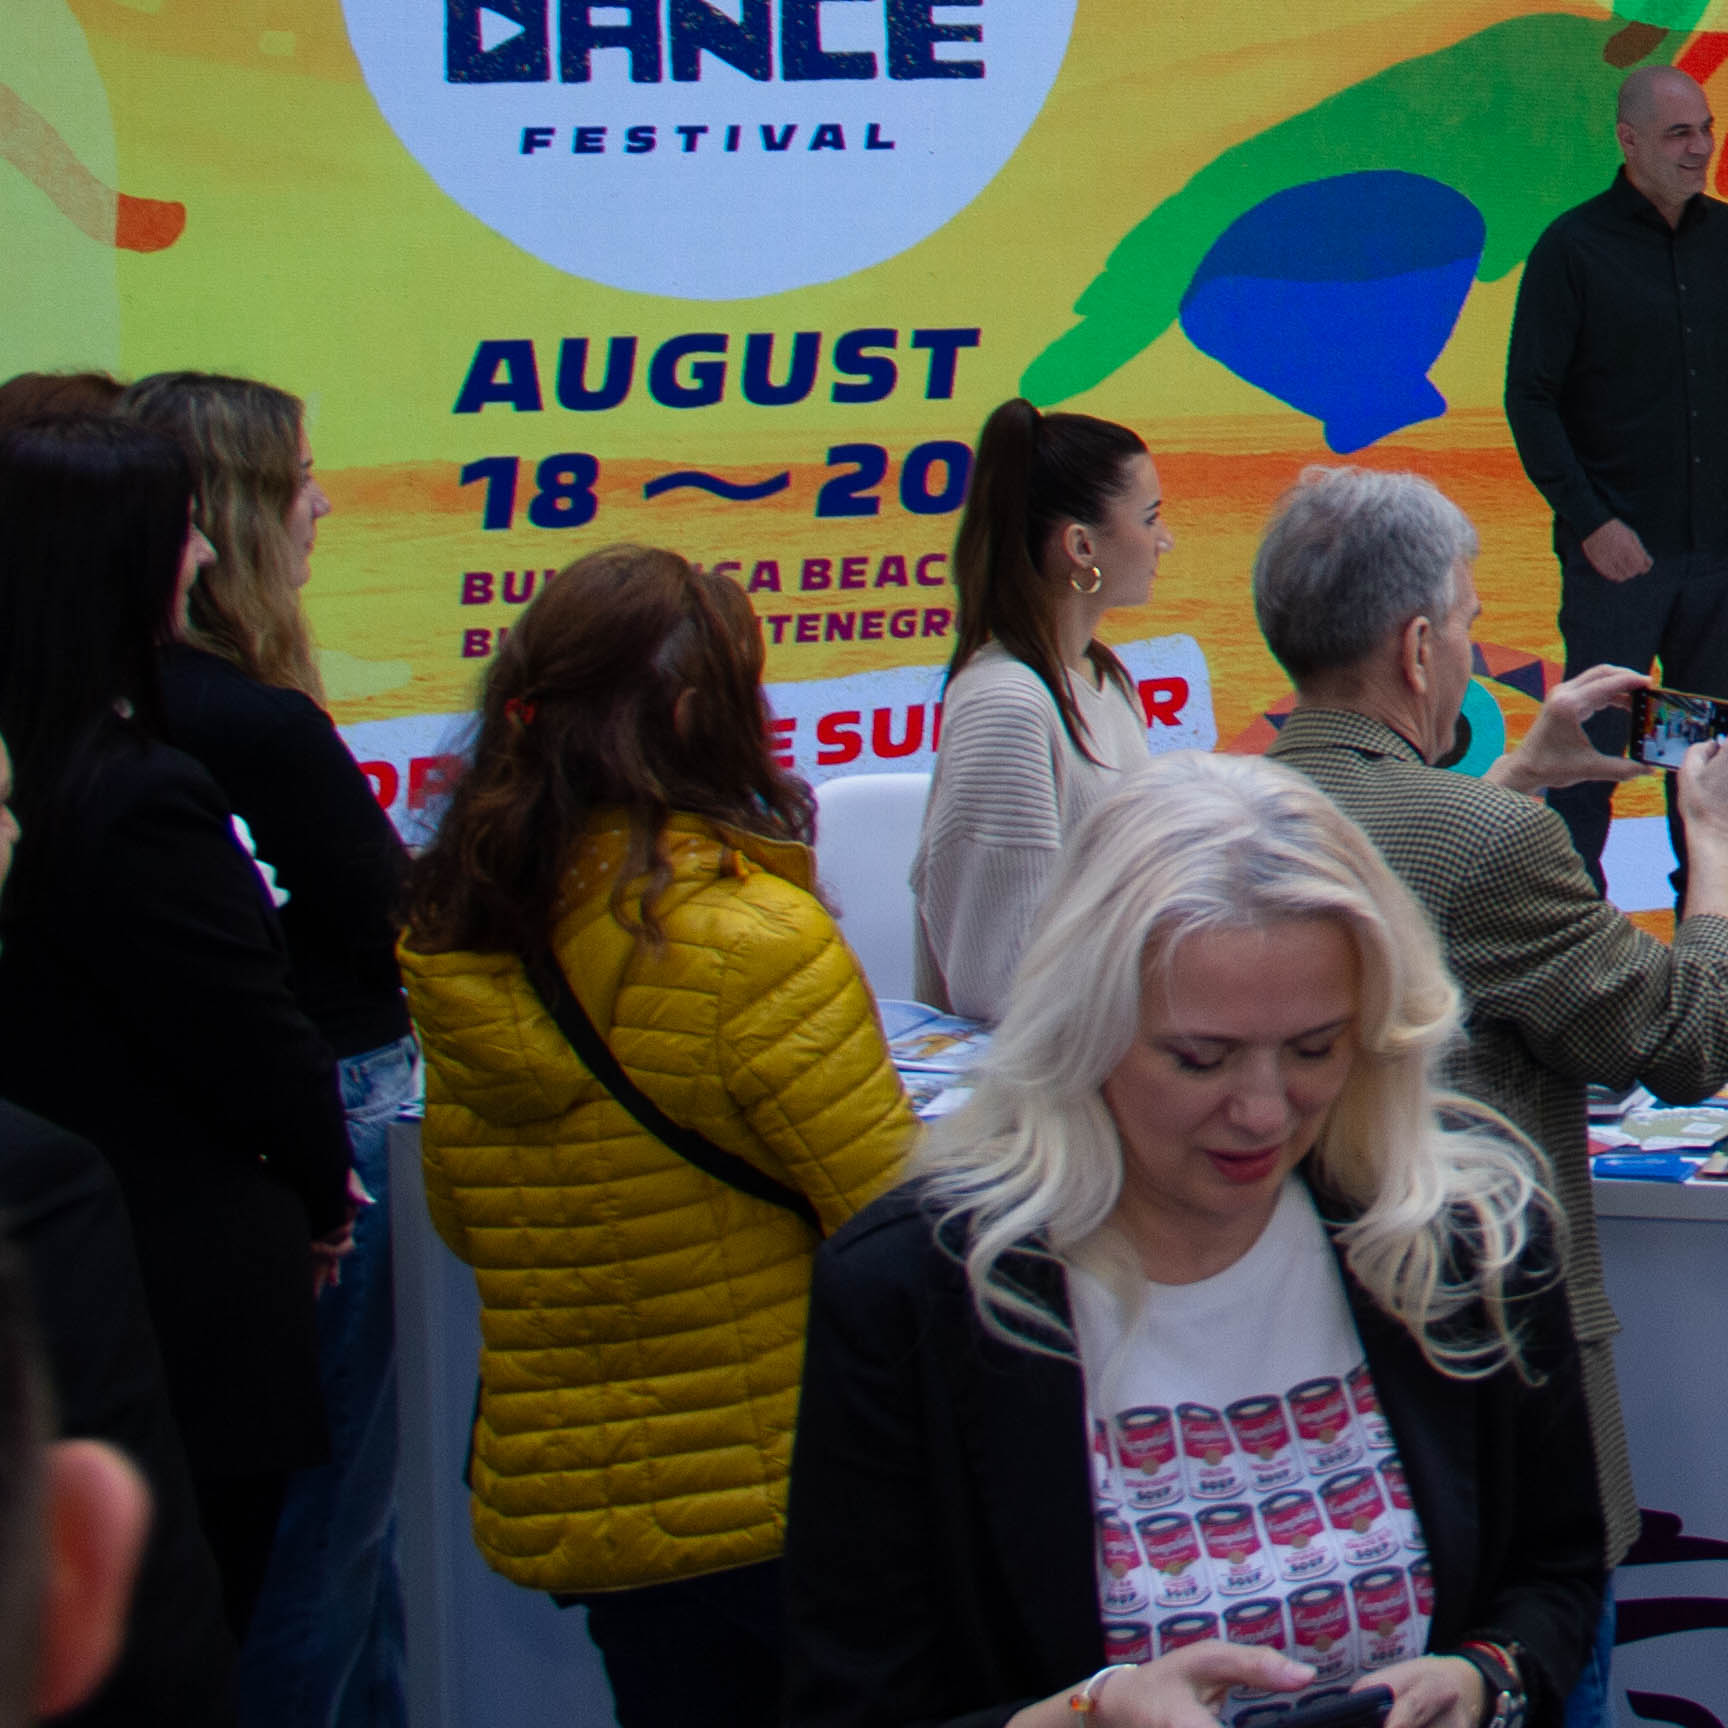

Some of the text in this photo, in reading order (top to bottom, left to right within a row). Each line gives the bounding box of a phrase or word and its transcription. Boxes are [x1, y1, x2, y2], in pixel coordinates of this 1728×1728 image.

[520, 123, 896, 155] FESTIVAL
[453, 327, 982, 415] AUGUST
[459, 452, 600, 531] 18
[815, 439, 974, 519] 20
[800, 552, 950, 593] BEAC
